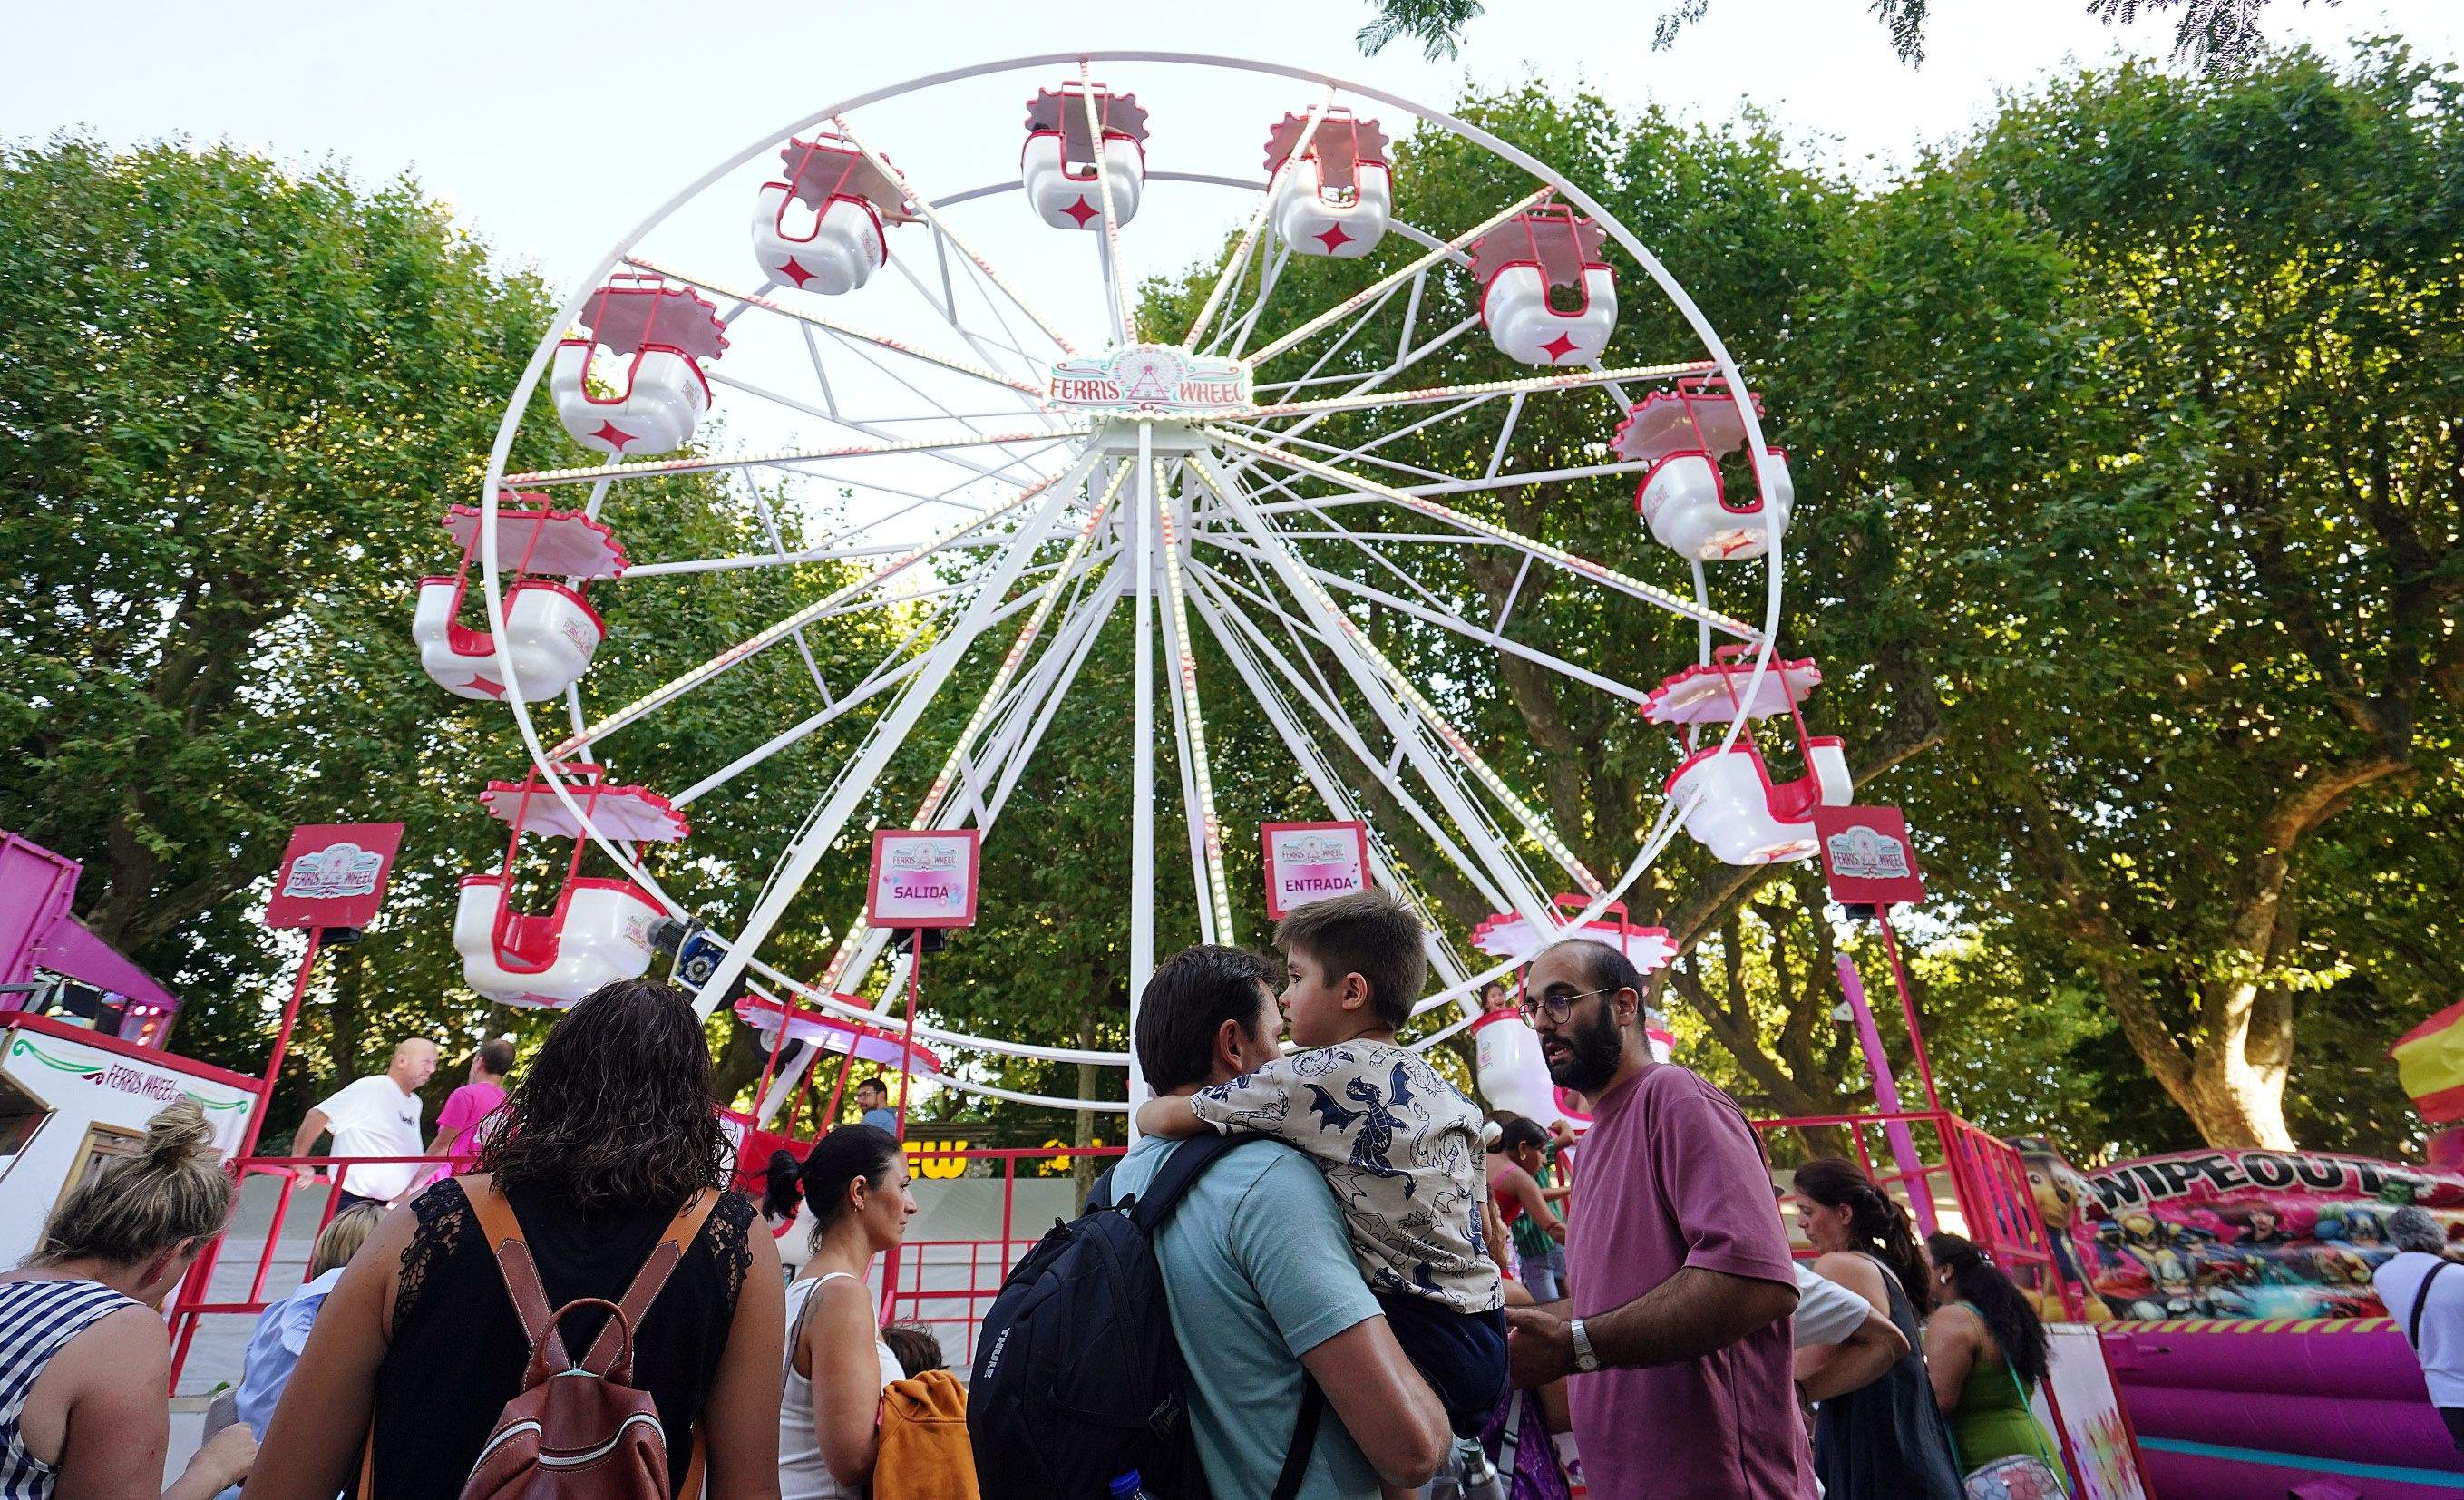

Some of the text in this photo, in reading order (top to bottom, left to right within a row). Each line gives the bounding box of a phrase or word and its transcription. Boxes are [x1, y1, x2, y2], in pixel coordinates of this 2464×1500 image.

[1050, 377, 1246, 403] FERRIS WHEEL
[893, 855, 956, 864] FERRIS WHEEL
[893, 886, 950, 899] SALIDA
[1285, 878, 1353, 891] ENTRADA
[105, 1063, 179, 1101] FERRIS WHEEL
[2090, 1154, 2385, 1210] WIPEOUT
[983, 1327, 1011, 1378] THULE
